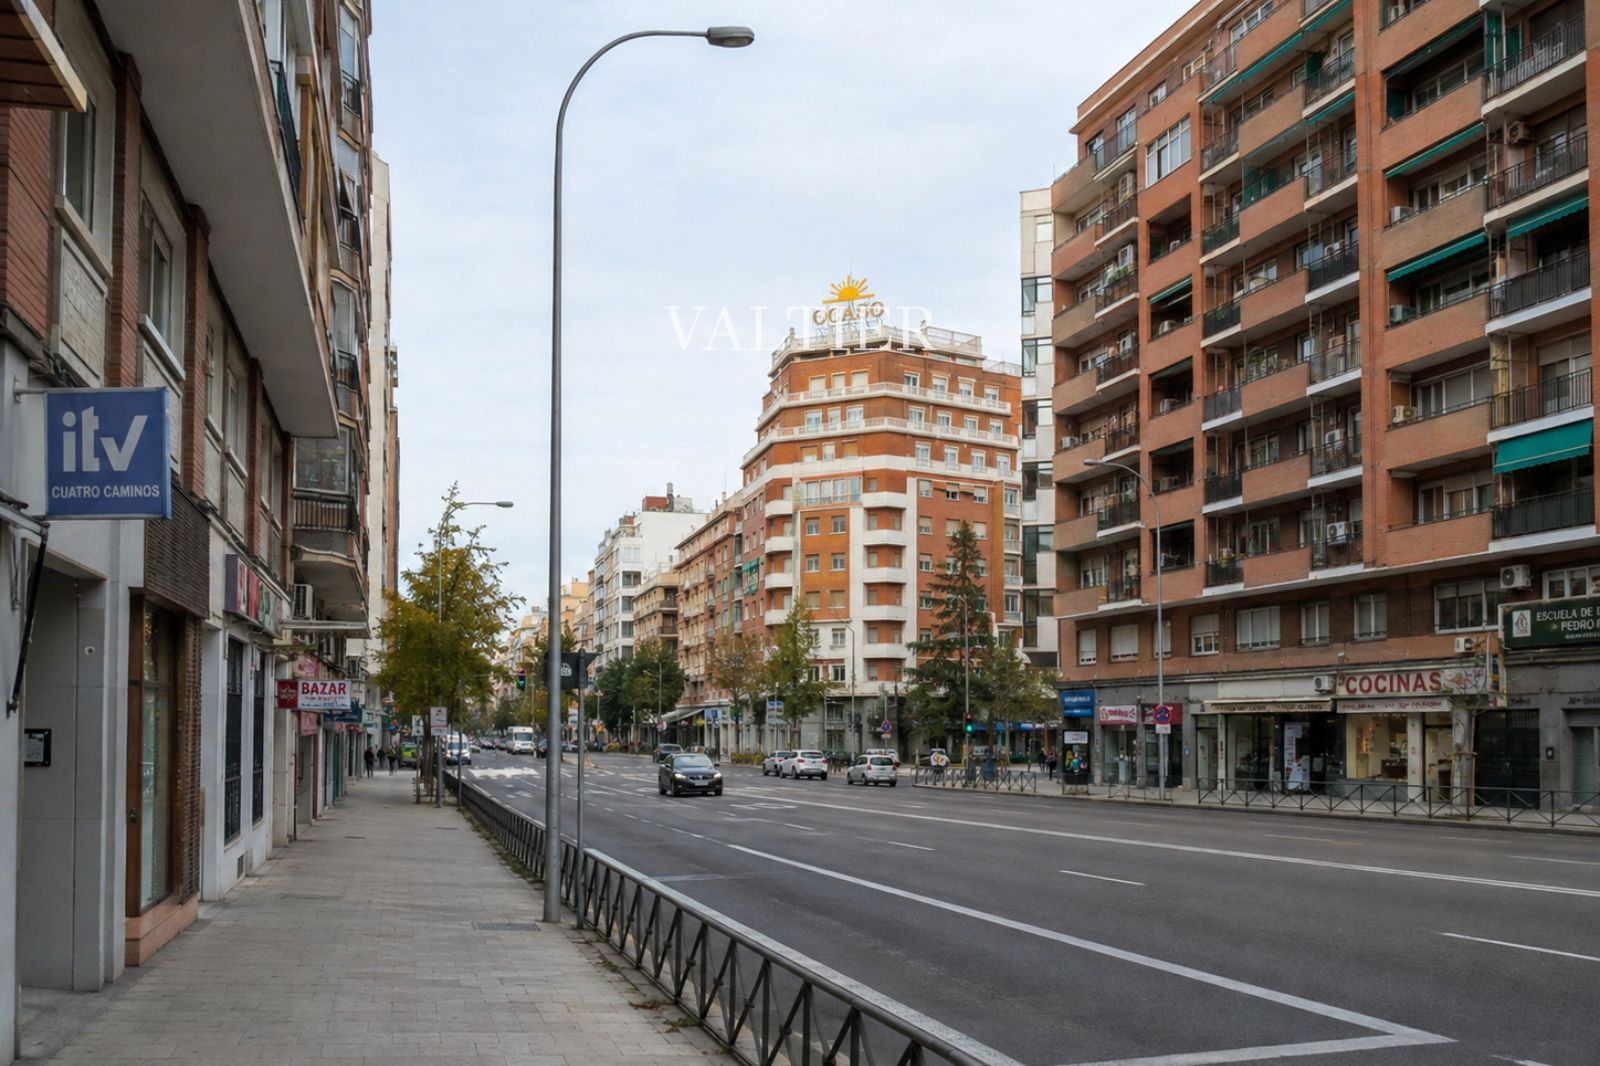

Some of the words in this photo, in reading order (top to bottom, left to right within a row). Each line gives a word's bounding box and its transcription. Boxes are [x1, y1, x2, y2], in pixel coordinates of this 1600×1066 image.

[812, 301, 885, 326] OCASO
[62, 406, 149, 472] itv
[52, 485, 100, 499] CUATRO
[103, 484, 160, 498] CAMINOS
[1536, 608, 1578, 622] ESCUELA
[1580, 606, 1593, 617] DE
[1561, 618, 1594, 632] PEDRO
[301, 682, 347, 696] BAZAR
[1345, 671, 1442, 695] COCINAS
